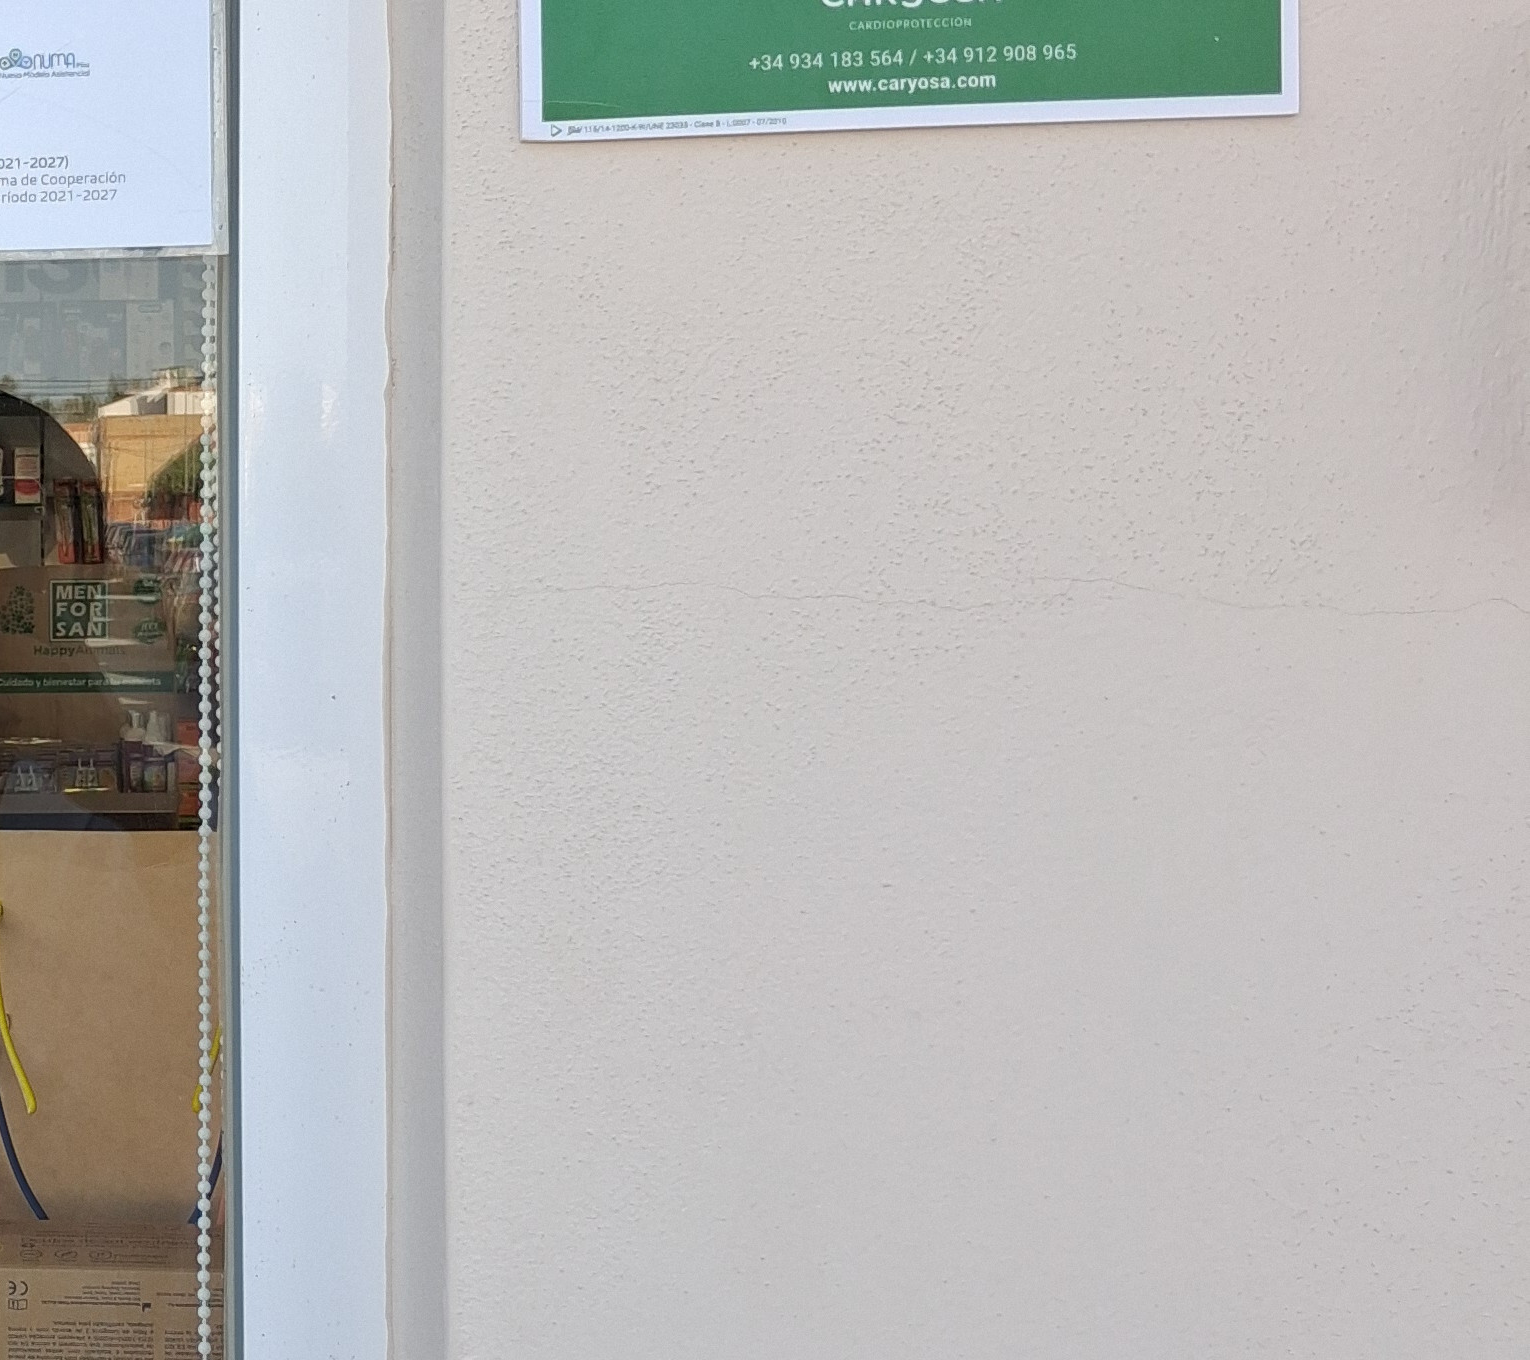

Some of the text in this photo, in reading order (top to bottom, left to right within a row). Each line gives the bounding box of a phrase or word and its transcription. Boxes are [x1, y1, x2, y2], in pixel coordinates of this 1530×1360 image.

[848, 16, 972, 31] CARDIOPROTECCIÓN
[748, 43, 1077, 71] +34 934 183 564 +34 912 908 965
[828, 73, 996, 94] www.caryosa.com
[21, 173, 37, 186] de
[40, 171, 126, 188] Cooperación
[40, 189, 118, 203] 2021-2027
[55, 584, 103, 600] MEN
[55, 601, 103, 618] FOR
[55, 621, 103, 638] SAN
